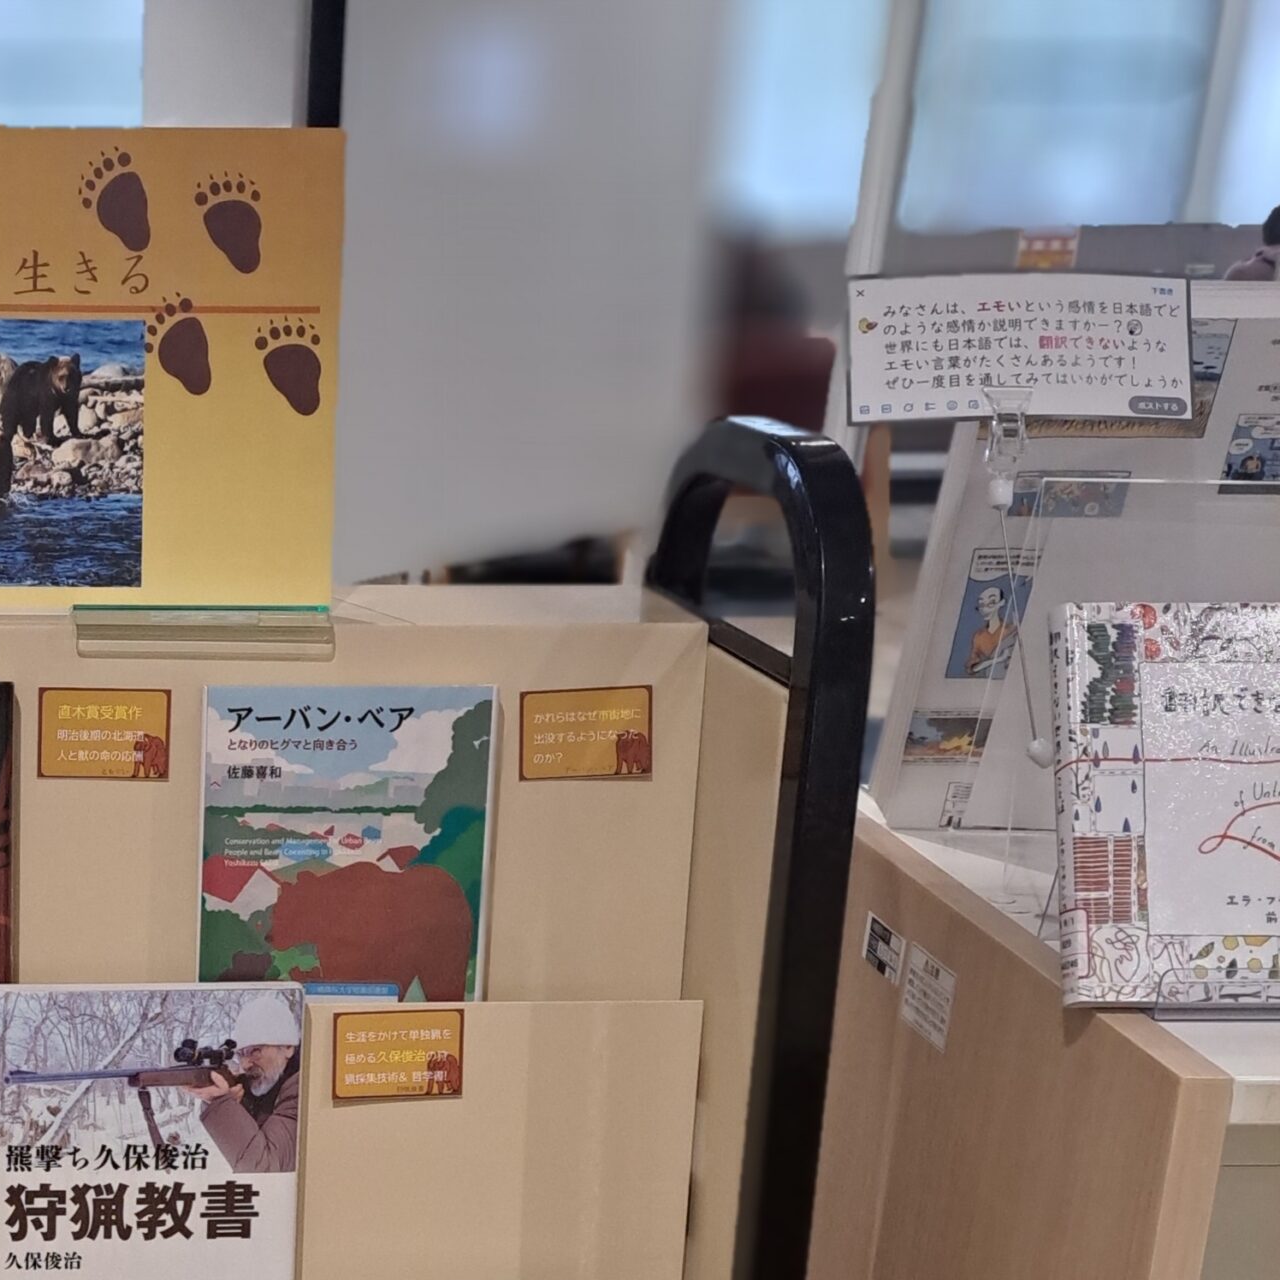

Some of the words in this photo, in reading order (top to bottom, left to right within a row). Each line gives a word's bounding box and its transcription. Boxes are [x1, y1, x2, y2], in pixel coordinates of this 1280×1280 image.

[883, 300, 1180, 318] みなさんは、エモいという感情を日本語でど
[884, 336, 1167, 354] 世界にも日本語では、翻訳できないような
[884, 354, 1137, 371] エモい言葉がたくさんあるようです！
[885, 372, 1183, 389] ぜひ一度目を通してみてはいかがでしょうか
[58, 705, 142, 720] 直木賞受賞作
[226, 706, 416, 734] アーバン・ベア
[227, 738, 358, 752] となりのヒグマと向き合う
[226, 765, 282, 780] 佐藤喜和
[5, 1143, 209, 1173] 羆撃ち久保俊治
[4, 1181, 260, 1242] 狩猟教書
[3, 1251, 83, 1271] 久保俊治
